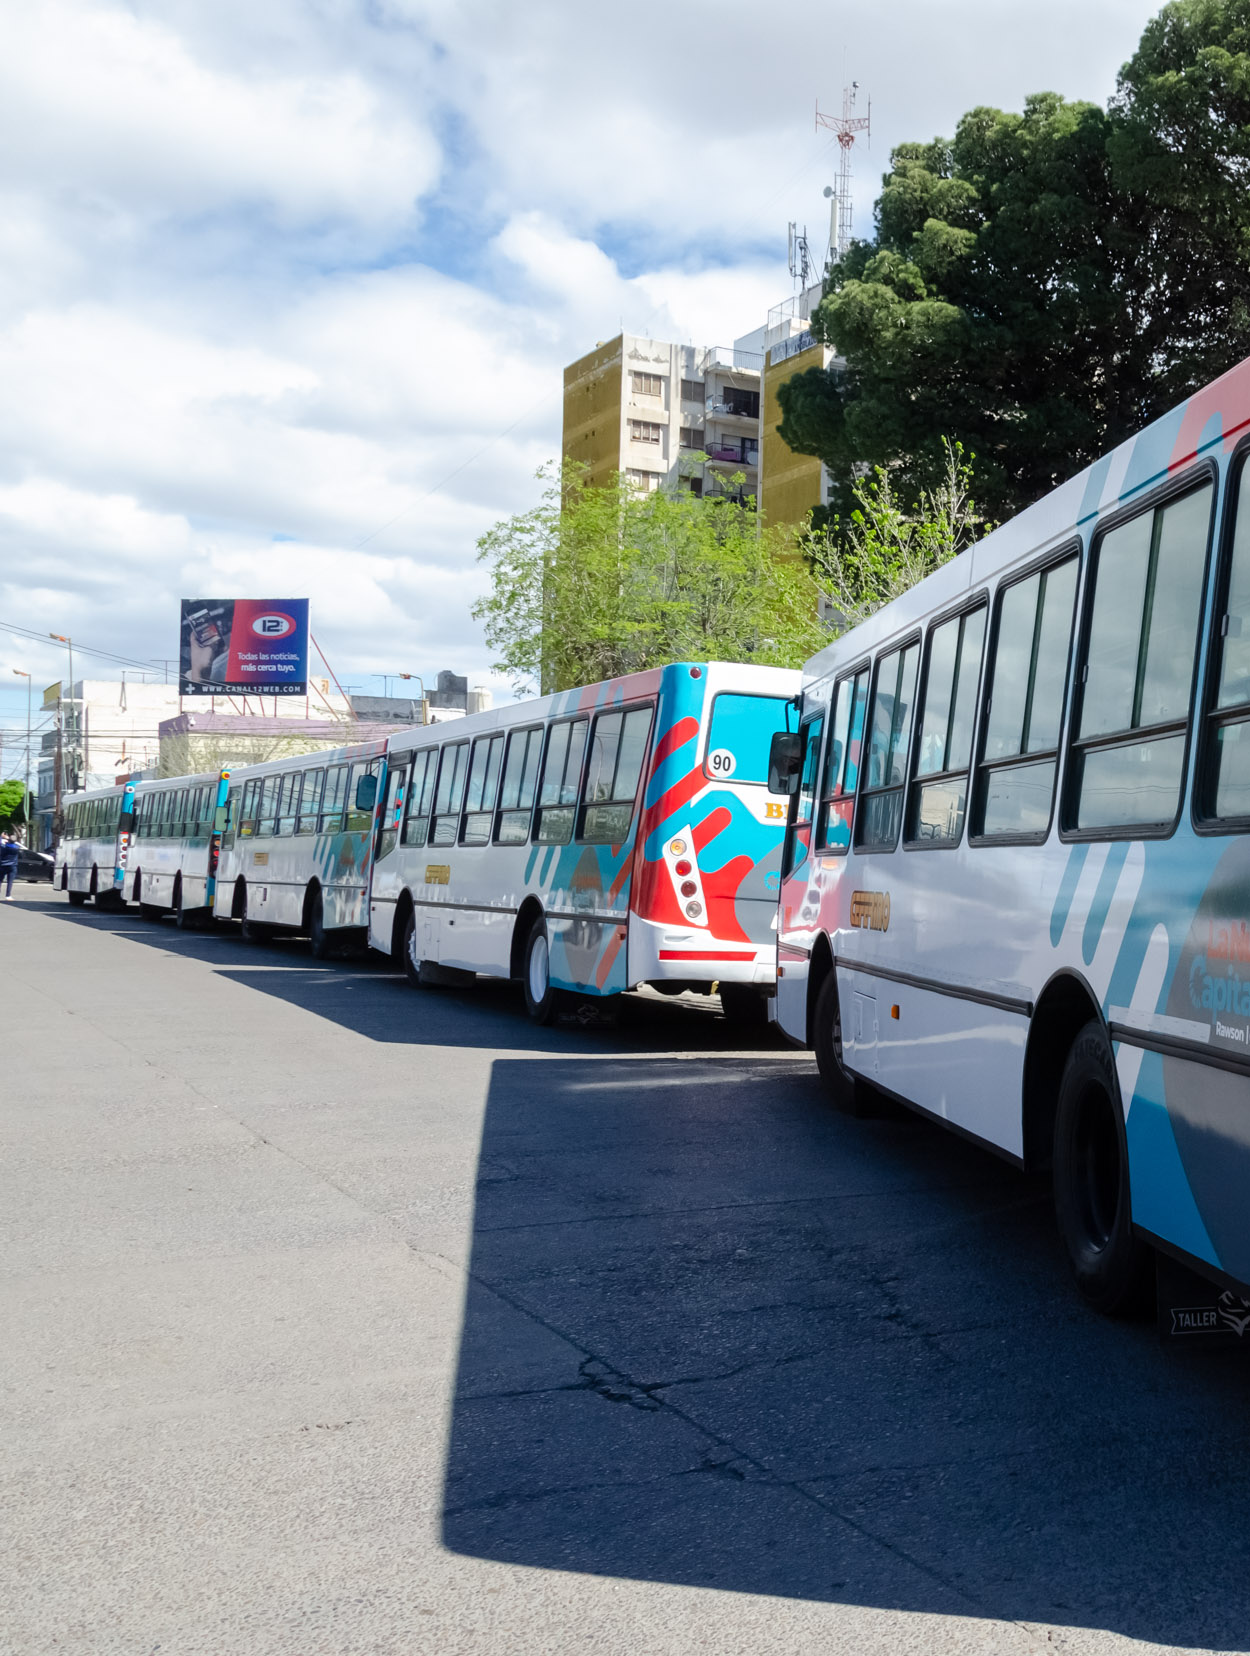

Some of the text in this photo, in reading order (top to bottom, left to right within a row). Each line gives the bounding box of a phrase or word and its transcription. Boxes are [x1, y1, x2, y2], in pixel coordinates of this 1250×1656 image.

[262, 619, 281, 632] 12
[237, 652, 300, 661] Todas las noticias,
[241, 663, 257, 671] más
[277, 663, 296, 674] tuyo.
[713, 754, 731, 771] 90
[1215, 1021, 1245, 1042] Rawson
[1178, 1311, 1217, 1328] TALLER
